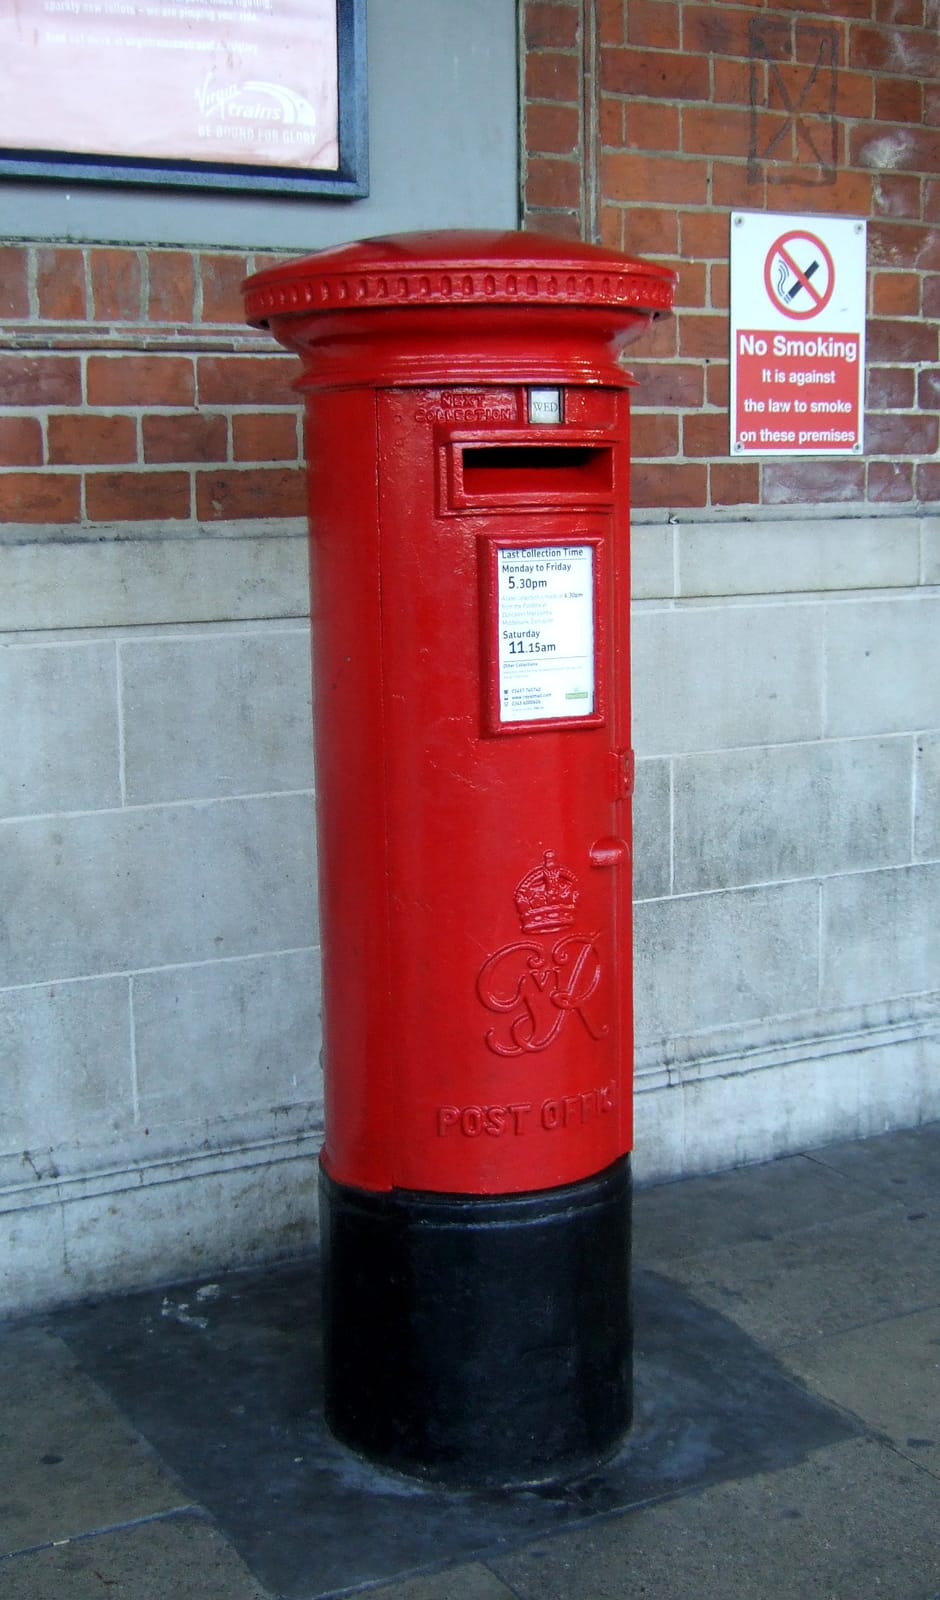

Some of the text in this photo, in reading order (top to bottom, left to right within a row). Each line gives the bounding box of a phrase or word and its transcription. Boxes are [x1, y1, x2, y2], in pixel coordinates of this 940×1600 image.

[194, 71, 242, 120] Virgin
[228, 103, 282, 121] trains
[198, 124, 317, 145] BE BOUND FOR GLORY
[740, 335, 857, 362] No Smoking
[762, 369, 836, 387] It is against
[441, 391, 486, 407] NEXT
[744, 398, 852, 413] the law to smoke
[414, 407, 511, 422] COLLECTION
[532, 401, 559, 413] WED
[740, 428, 855, 444] on these premises
[502, 547, 583, 559] Last Collection Time
[502, 562, 571, 574] Monday to Friday
[508, 575, 547, 590] 5.30pm
[503, 630, 540, 640] Saturday
[509, 640, 556, 654] 11.15am
[437, 1103, 532, 1138] POST
